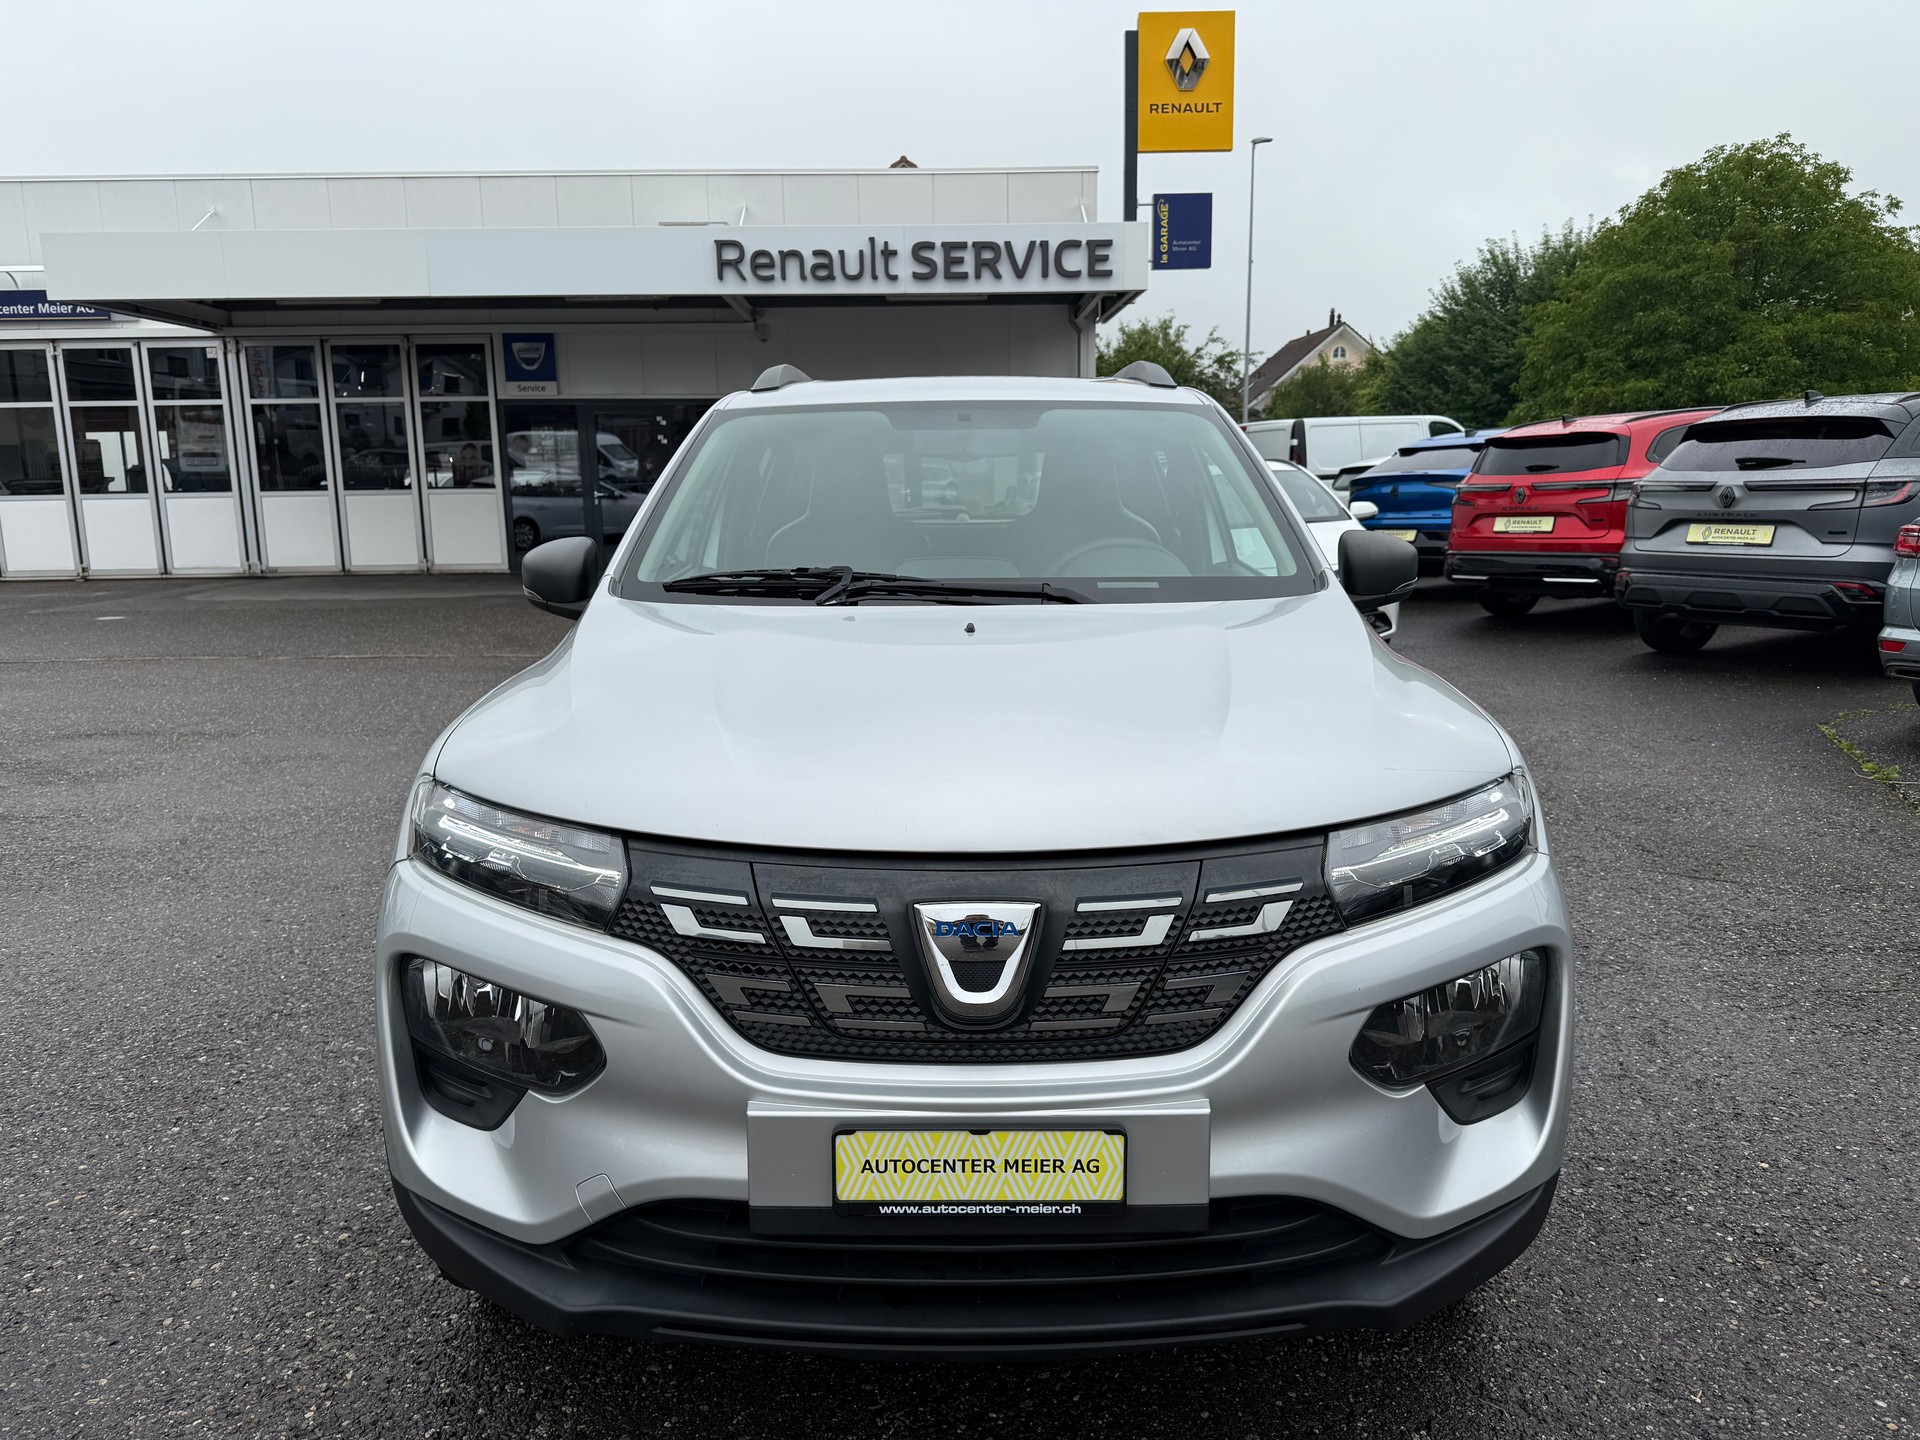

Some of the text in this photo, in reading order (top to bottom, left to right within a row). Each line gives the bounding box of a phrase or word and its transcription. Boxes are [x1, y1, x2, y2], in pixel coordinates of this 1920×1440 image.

[1149, 102, 1223, 114] RENAULT
[1160, 203, 1168, 252] GARAGE
[714, 236, 1113, 281] Renault SERVICE
[38, 303, 73, 314] Meier
[517, 384, 546, 392] Service
[935, 921, 1019, 937] DACIA
[861, 1159, 1100, 1174] AUTOCENTER MEIER AG
[879, 1203, 1081, 1214] www.autocenter-meier.ch
